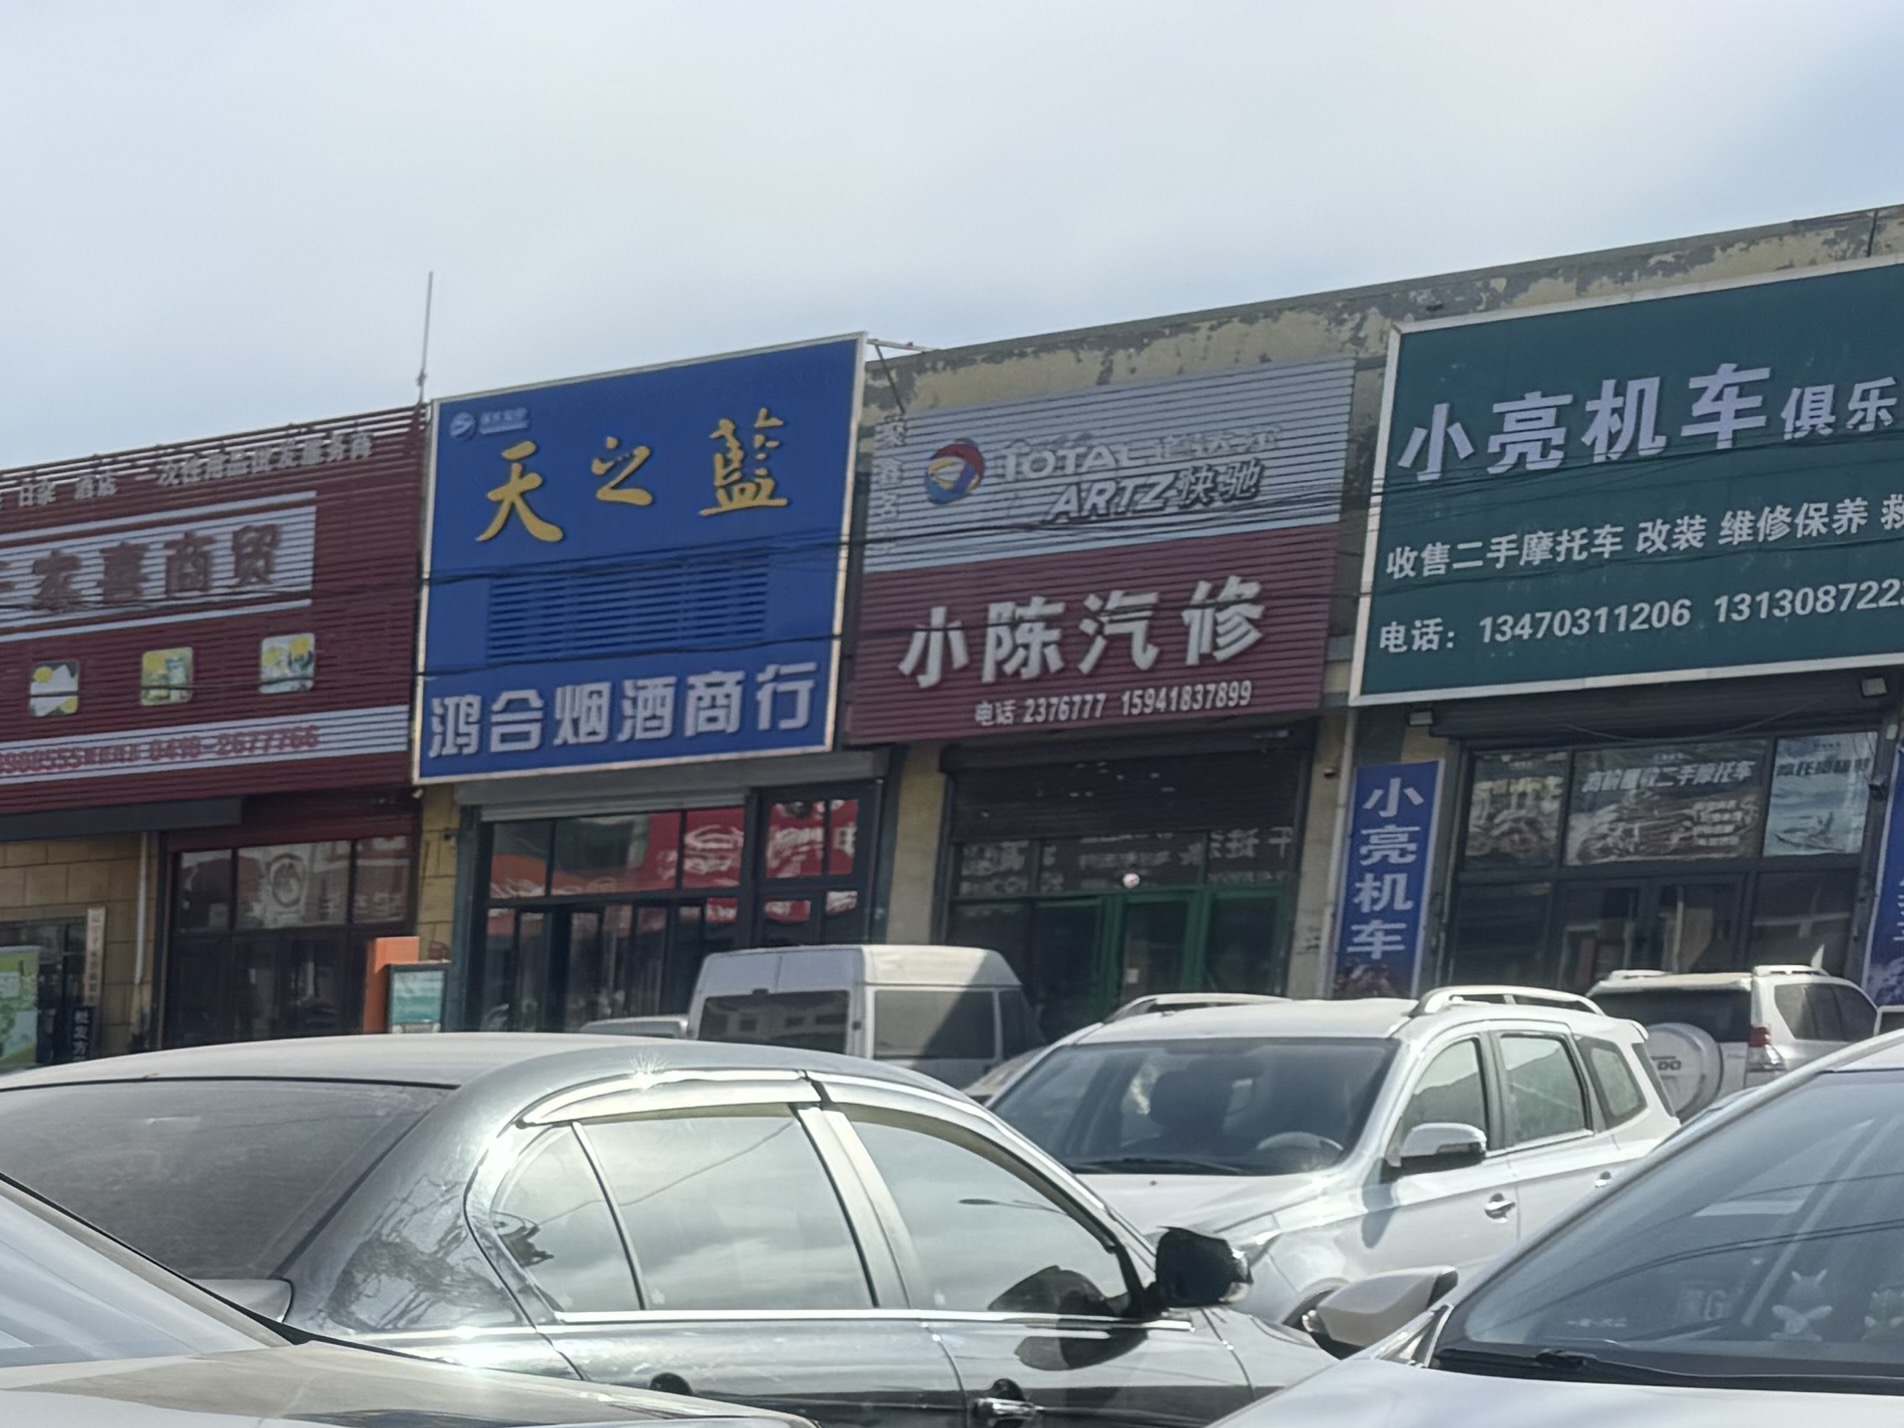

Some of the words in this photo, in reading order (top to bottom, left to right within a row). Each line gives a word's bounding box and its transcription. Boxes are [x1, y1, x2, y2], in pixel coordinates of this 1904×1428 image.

[997, 445, 1147, 481] TOTAL
[1386, 524, 1625, 581] 收售二手摩托车
[1636, 516, 1707, 555] 改装
[1718, 497, 1868, 547] 维修保养
[897, 574, 1266, 689] 小陈汽修
[1478, 598, 1692, 644] 13470311206
[1714, 577, 1904, 623] 131308722
[428, 662, 817, 758] 鸿合烟酒商行
[975, 700, 1017, 726] 电话
[1023, 693, 1106, 723] 2376777
[1121, 679, 1253, 716] 15941837899
[1347, 777, 1424, 960] 小亮机车
